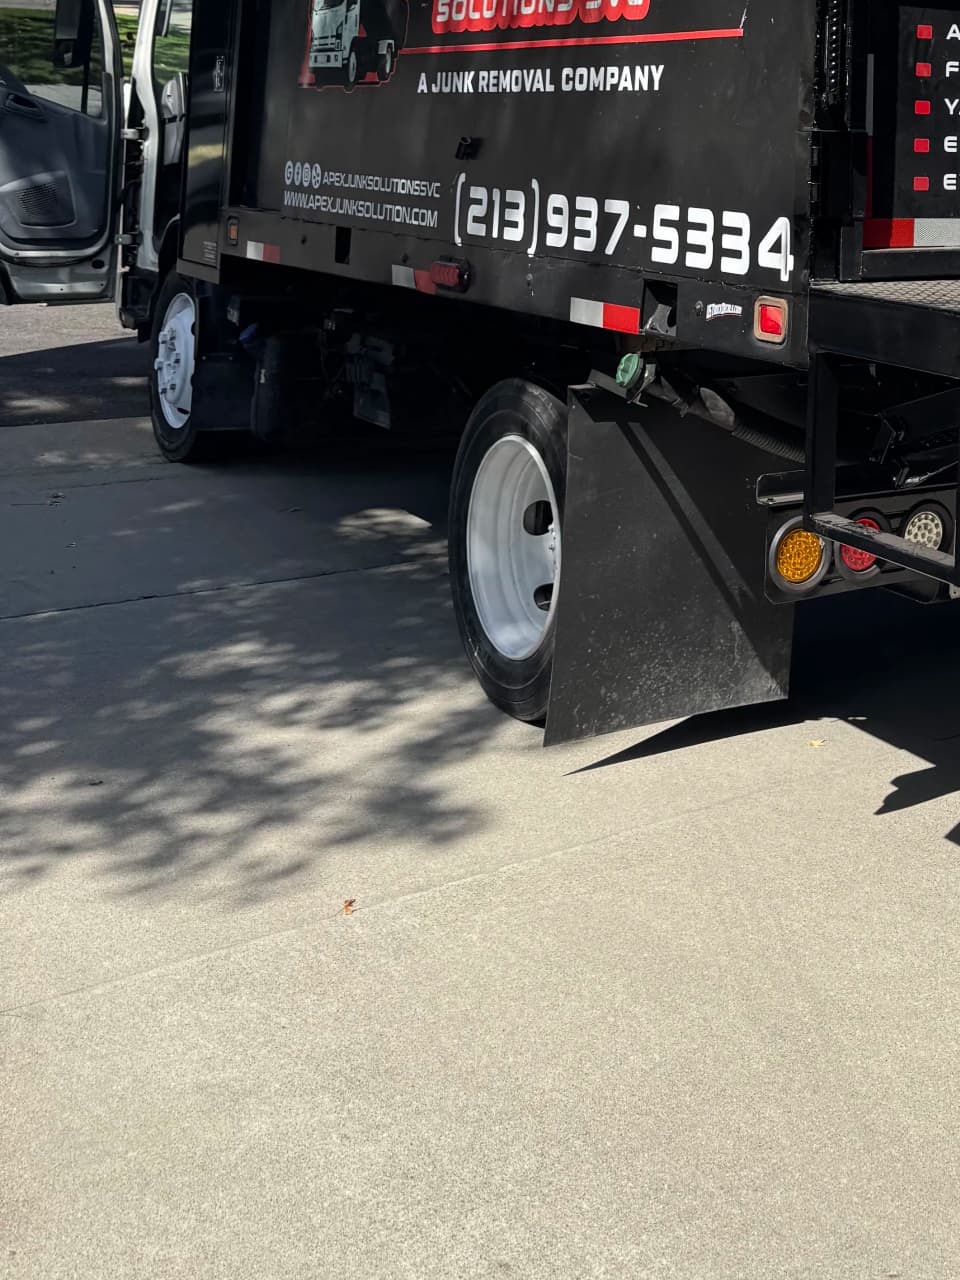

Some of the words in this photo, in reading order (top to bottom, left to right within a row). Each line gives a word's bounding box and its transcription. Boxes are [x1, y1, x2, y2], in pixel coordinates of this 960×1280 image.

[417, 73, 429, 94] A
[432, 71, 474, 94] JUNK
[478, 67, 555, 94] REMOVAL
[561, 64, 664, 92] COMPANY
[323, 171, 440, 198] APEXJUNKSOLUTIONSSVC
[284, 190, 438, 228] WWW.APEXJUNKSOLUTION.COM
[454, 173, 794, 282] (213)937-5334
